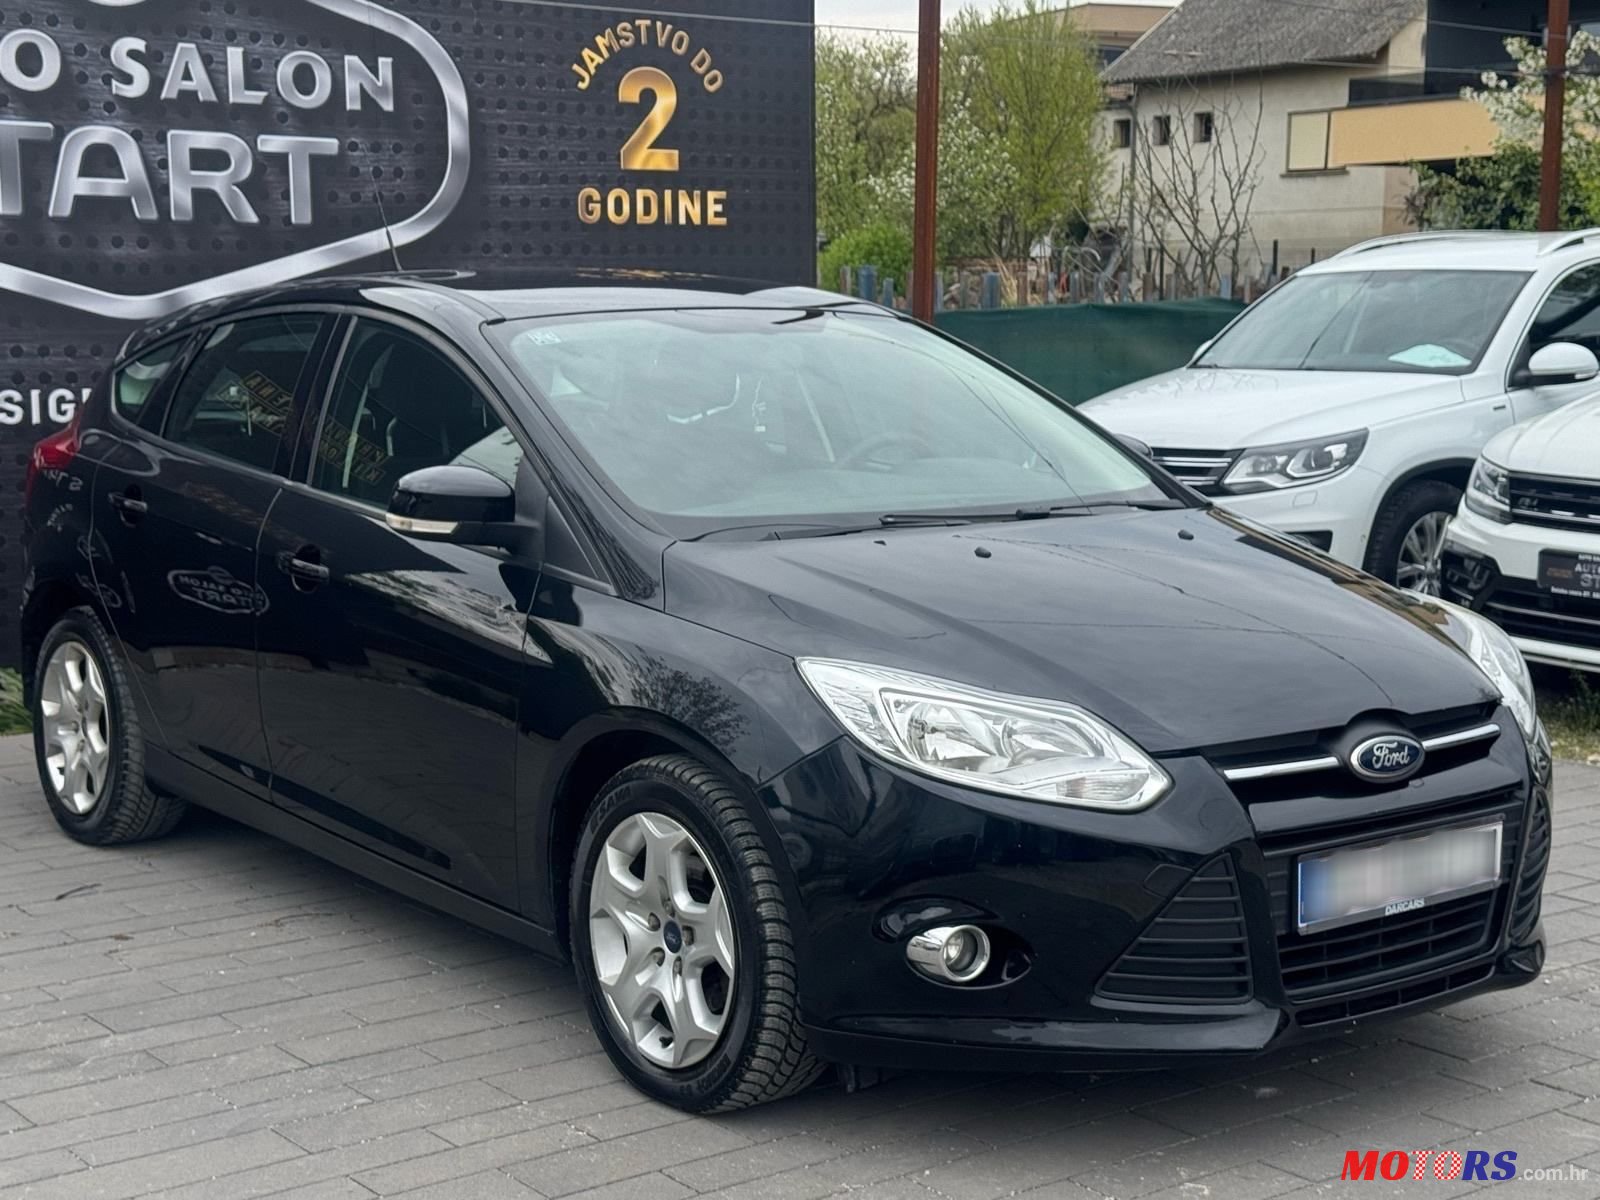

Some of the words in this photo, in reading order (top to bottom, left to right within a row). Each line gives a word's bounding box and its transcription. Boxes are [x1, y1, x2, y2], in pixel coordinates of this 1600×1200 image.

[110, 37, 394, 112] SALON
[571, 19, 690, 91] JAMSTVO
[690, 48, 724, 93] DO
[618, 66, 680, 171] 2
[577, 187, 728, 226] GODINE
[1372, 741, 1411, 769] Ford
